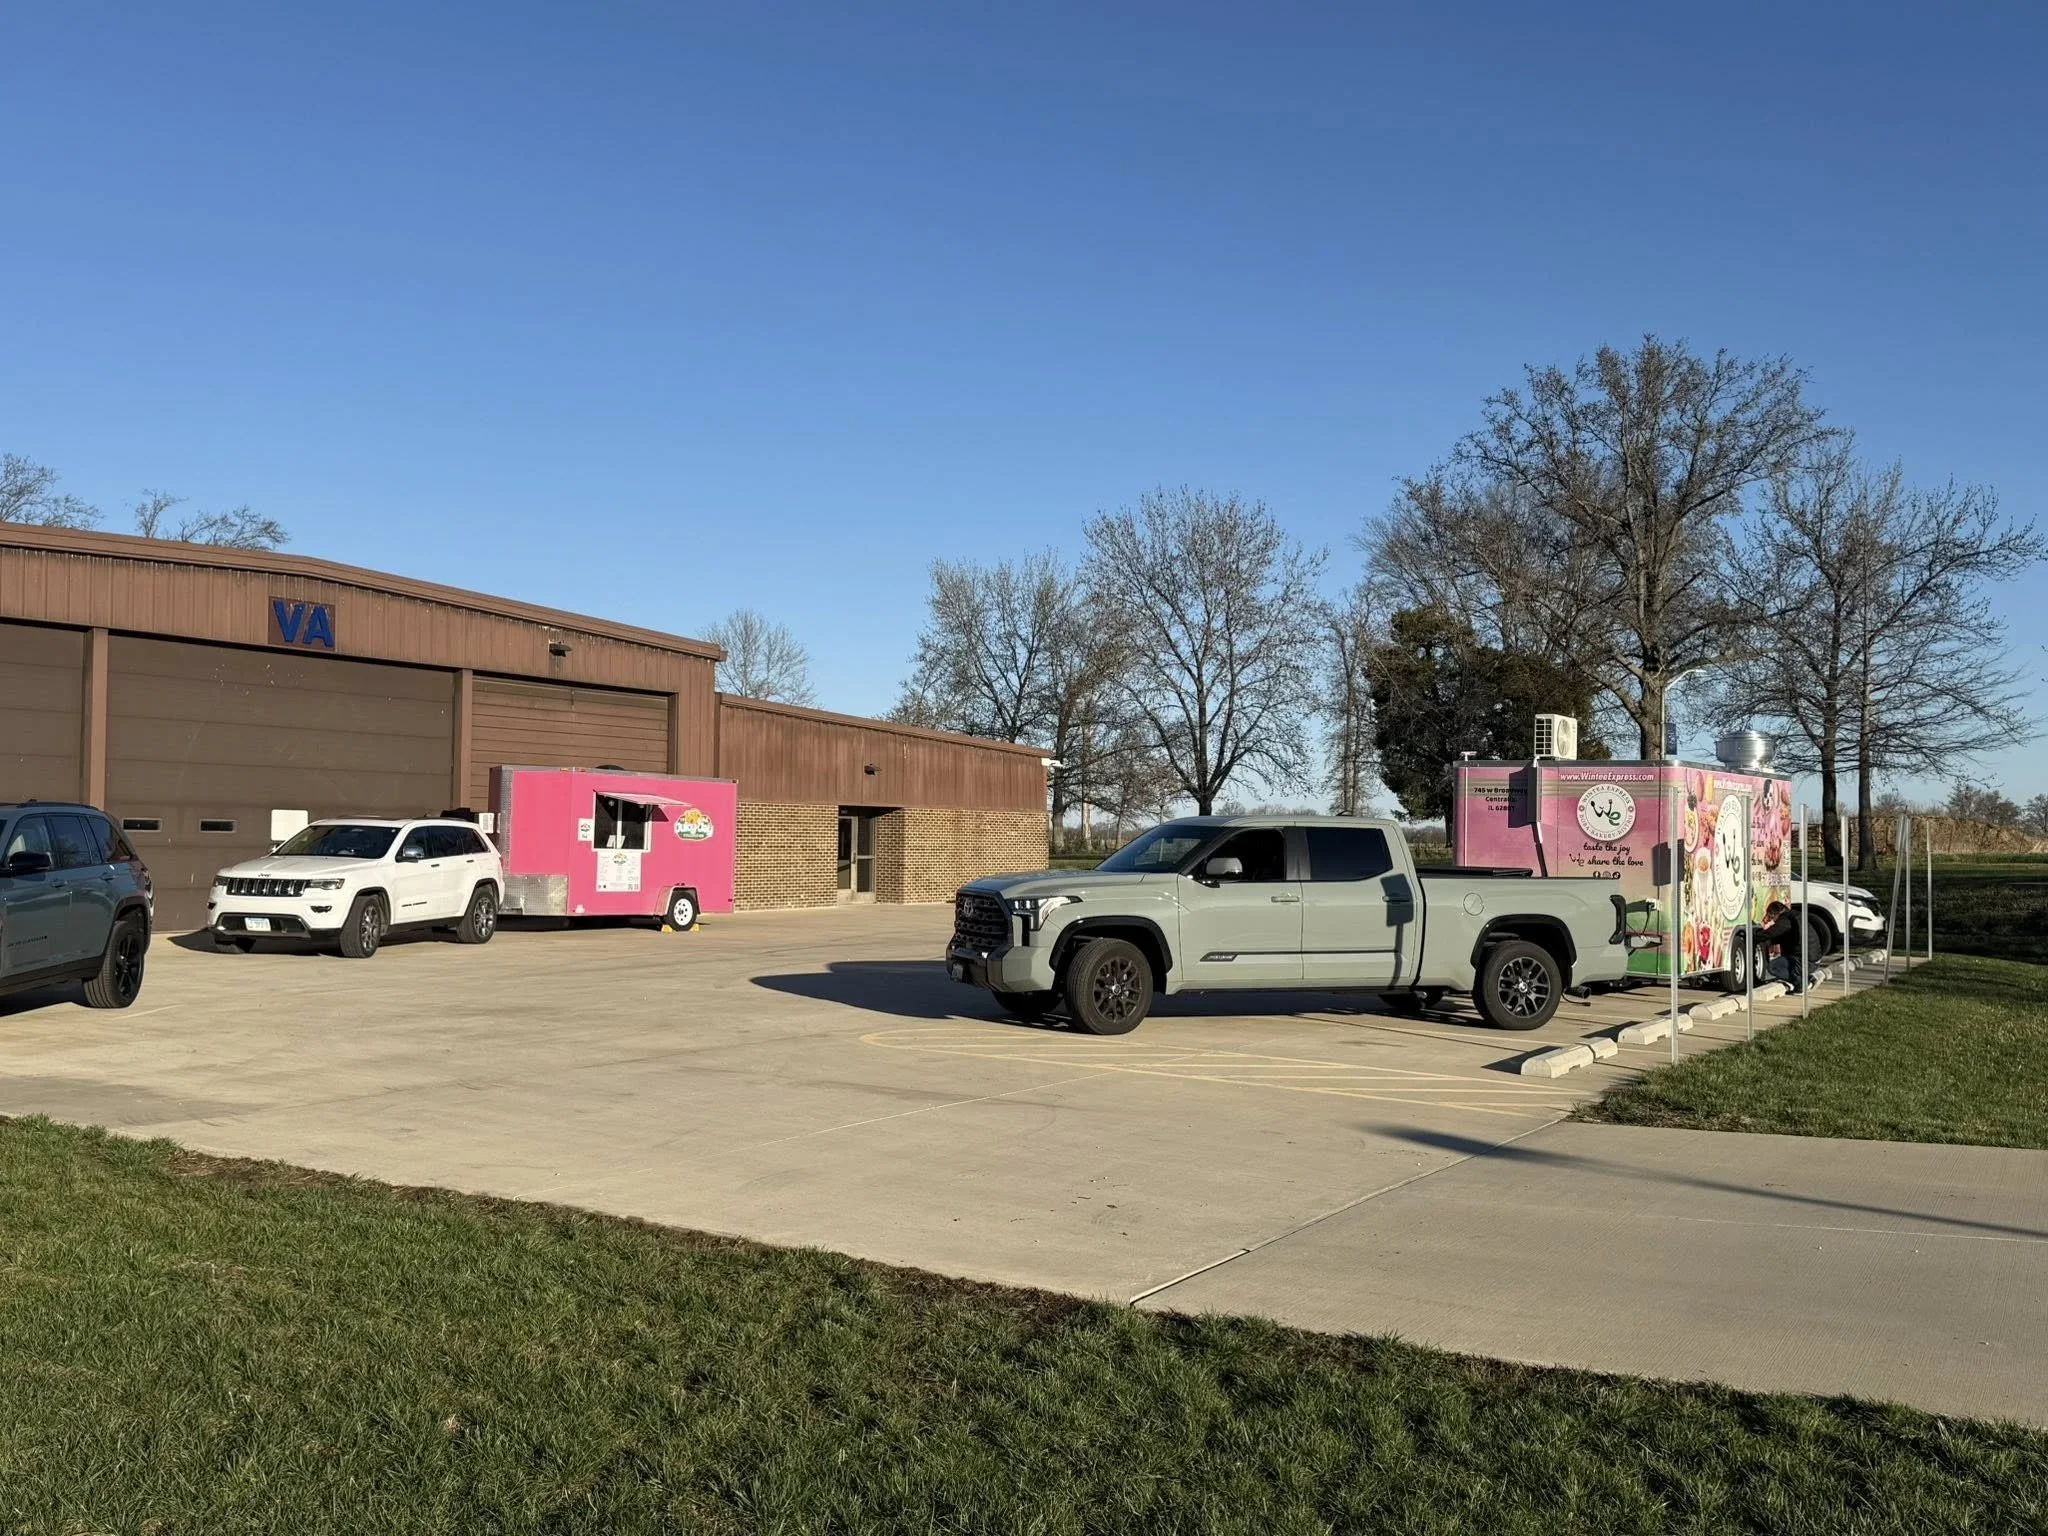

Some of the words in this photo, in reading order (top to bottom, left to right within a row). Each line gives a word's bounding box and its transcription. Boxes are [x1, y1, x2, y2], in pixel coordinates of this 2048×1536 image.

[273, 600, 334, 648] VA
[1560, 772, 1654, 782] www.WinteaExpress.com
[1583, 842, 1602, 851] taste
[1605, 842, 1617, 851] the
[1617, 844, 1630, 856] joy
[1587, 855, 1610, 865] share
[1612, 855, 1625, 865] the
[1627, 857, 1644, 866] love
